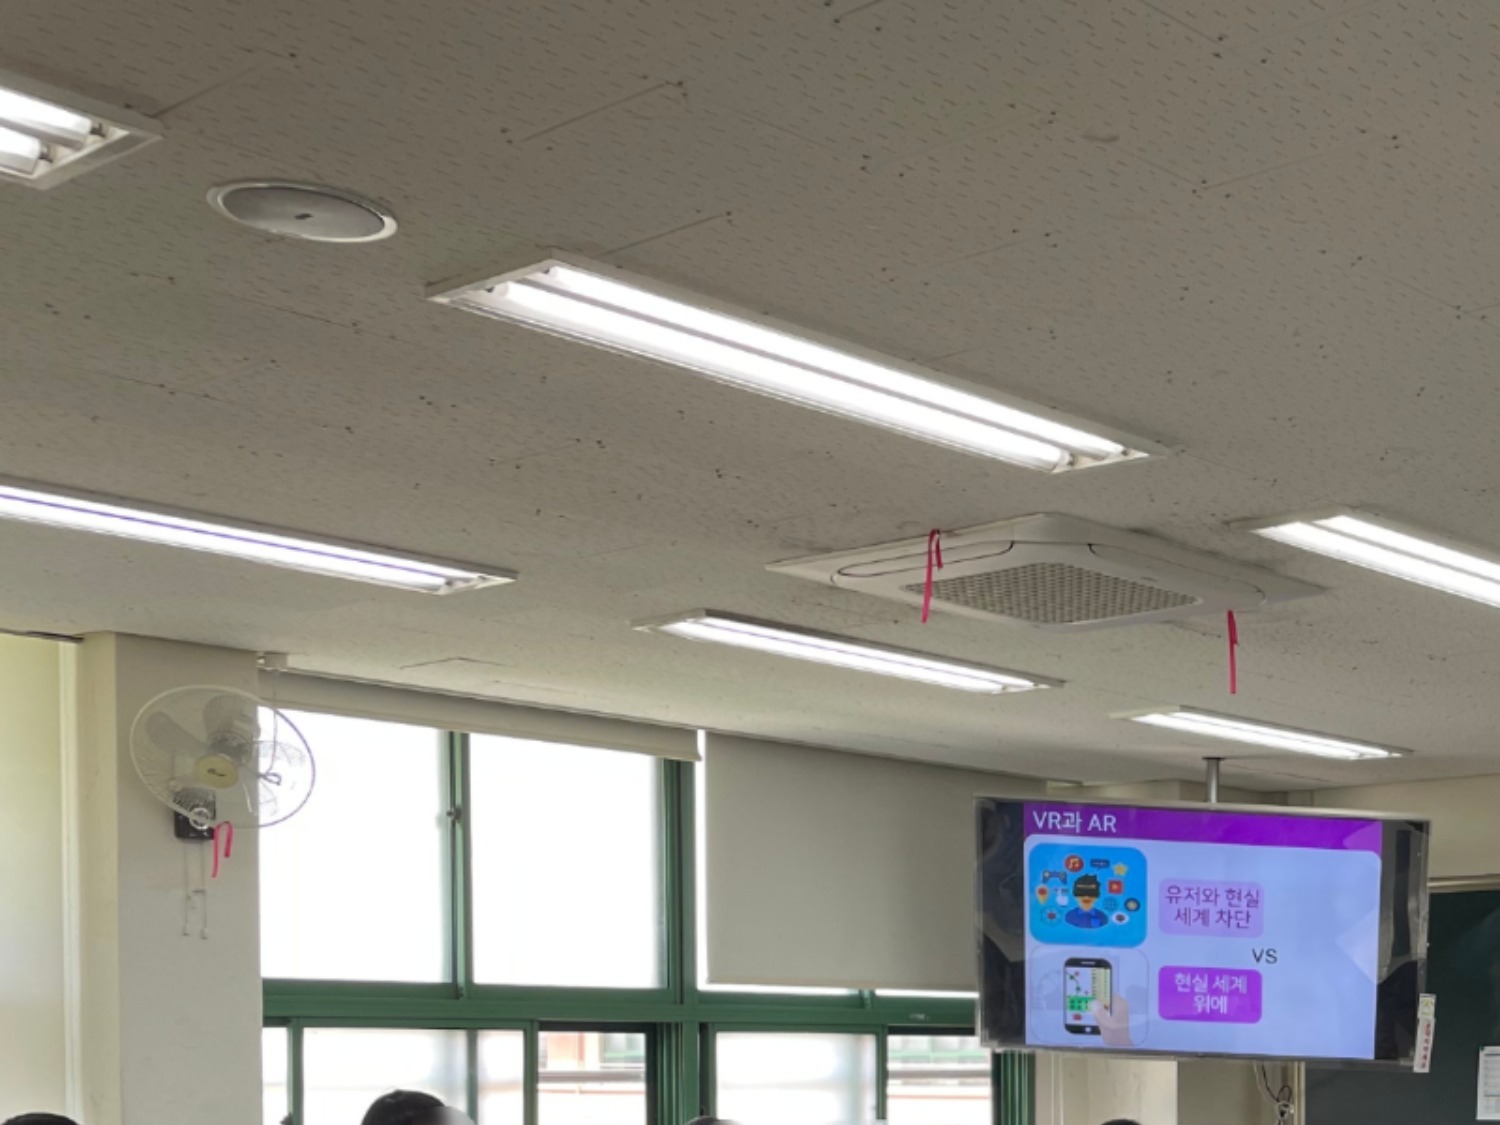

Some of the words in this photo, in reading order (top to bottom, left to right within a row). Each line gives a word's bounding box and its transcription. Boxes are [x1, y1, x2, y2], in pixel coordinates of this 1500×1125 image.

[1033, 811, 1082, 834] VR과
[1088, 814, 1117, 833] AR
[1165, 886, 1220, 908] 유저와
[1225, 887, 1260, 909] 현실
[1173, 907, 1210, 928] 세계
[1215, 909, 1251, 930] 차단
[1252, 947, 1278, 964] VS
[1175, 972, 1208, 994] 현실
[1212, 974, 1247, 994] 세계
[1193, 995, 1228, 1014] 위에
